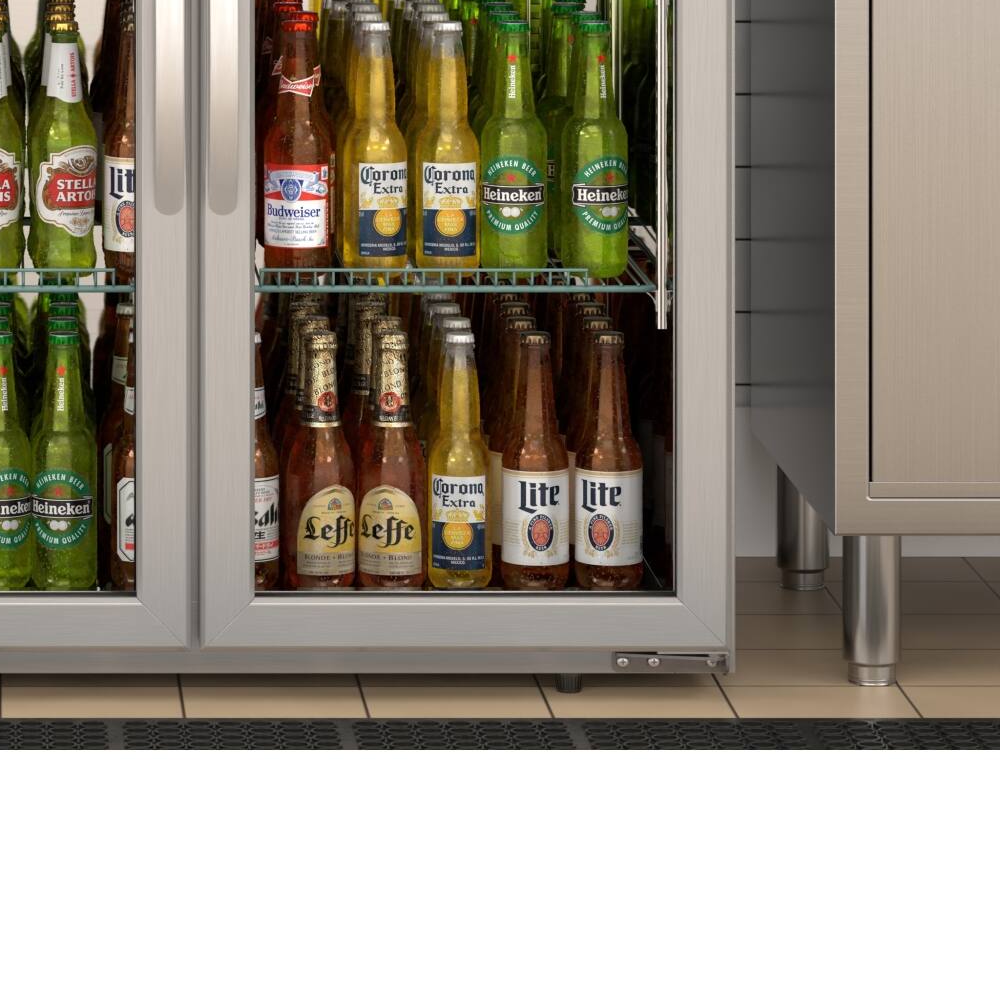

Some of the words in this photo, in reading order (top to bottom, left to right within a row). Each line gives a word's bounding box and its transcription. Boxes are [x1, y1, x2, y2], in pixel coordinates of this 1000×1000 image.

[508, 65, 516, 99] Heineken
[424, 165, 476, 187] Corona
[487, 160, 519, 177] HEINEKEN
[521, 160, 537, 177] BEER
[583, 160, 617, 178] HEINEKEN
[109, 166, 134, 200] Lit
[373, 182, 403, 195] Extra
[435, 182, 469, 195] Extra
[483, 187, 542, 202] Heineken
[577, 188, 628, 202] Heineke
[267, 203, 321, 218] Budweiser
[486, 210, 512, 231] PREMIUM
[514, 211, 538, 231] QUALITY
[582, 211, 612, 231] PREMIUM
[57, 377, 65, 412] Heineken
[36, 473, 66, 489] HEINEKEN
[68, 475, 85, 490] BEER
[433, 478, 484, 498] Corona
[442, 495, 476, 507] Extra
[518, 480, 560, 514] Lite
[581, 478, 622, 513] Lite
[32, 500, 90, 516] Heineken
[35, 523, 59, 544] PREMIUM
[62, 524, 86, 544] QUALITY
[361, 514, 416, 548] Leffe
